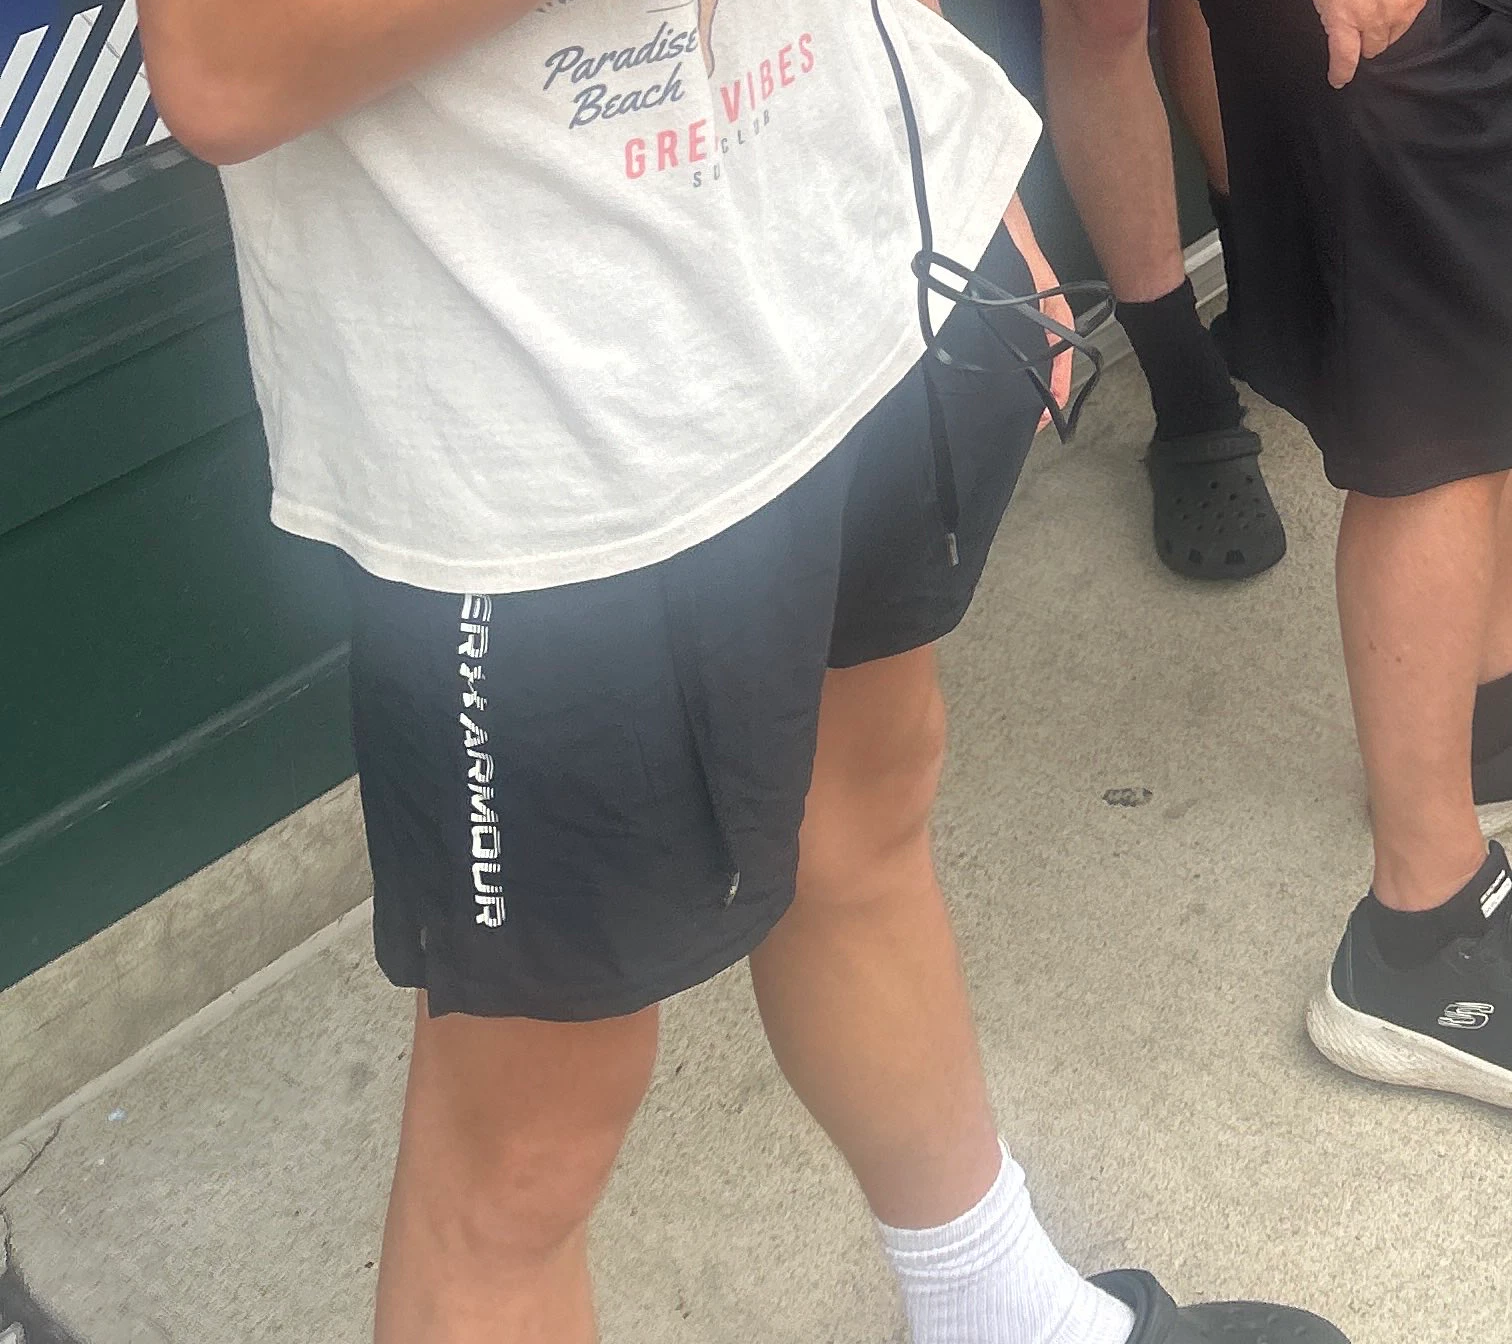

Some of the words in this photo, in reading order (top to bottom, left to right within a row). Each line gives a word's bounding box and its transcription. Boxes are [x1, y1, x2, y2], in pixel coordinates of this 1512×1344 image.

[543, 21, 699, 91] Paradise
[569, 62, 685, 130] Beach
[624, 118, 719, 180] GRE
[720, 32, 816, 124] VIBES
[460, 712, 506, 928] ARMOUR
